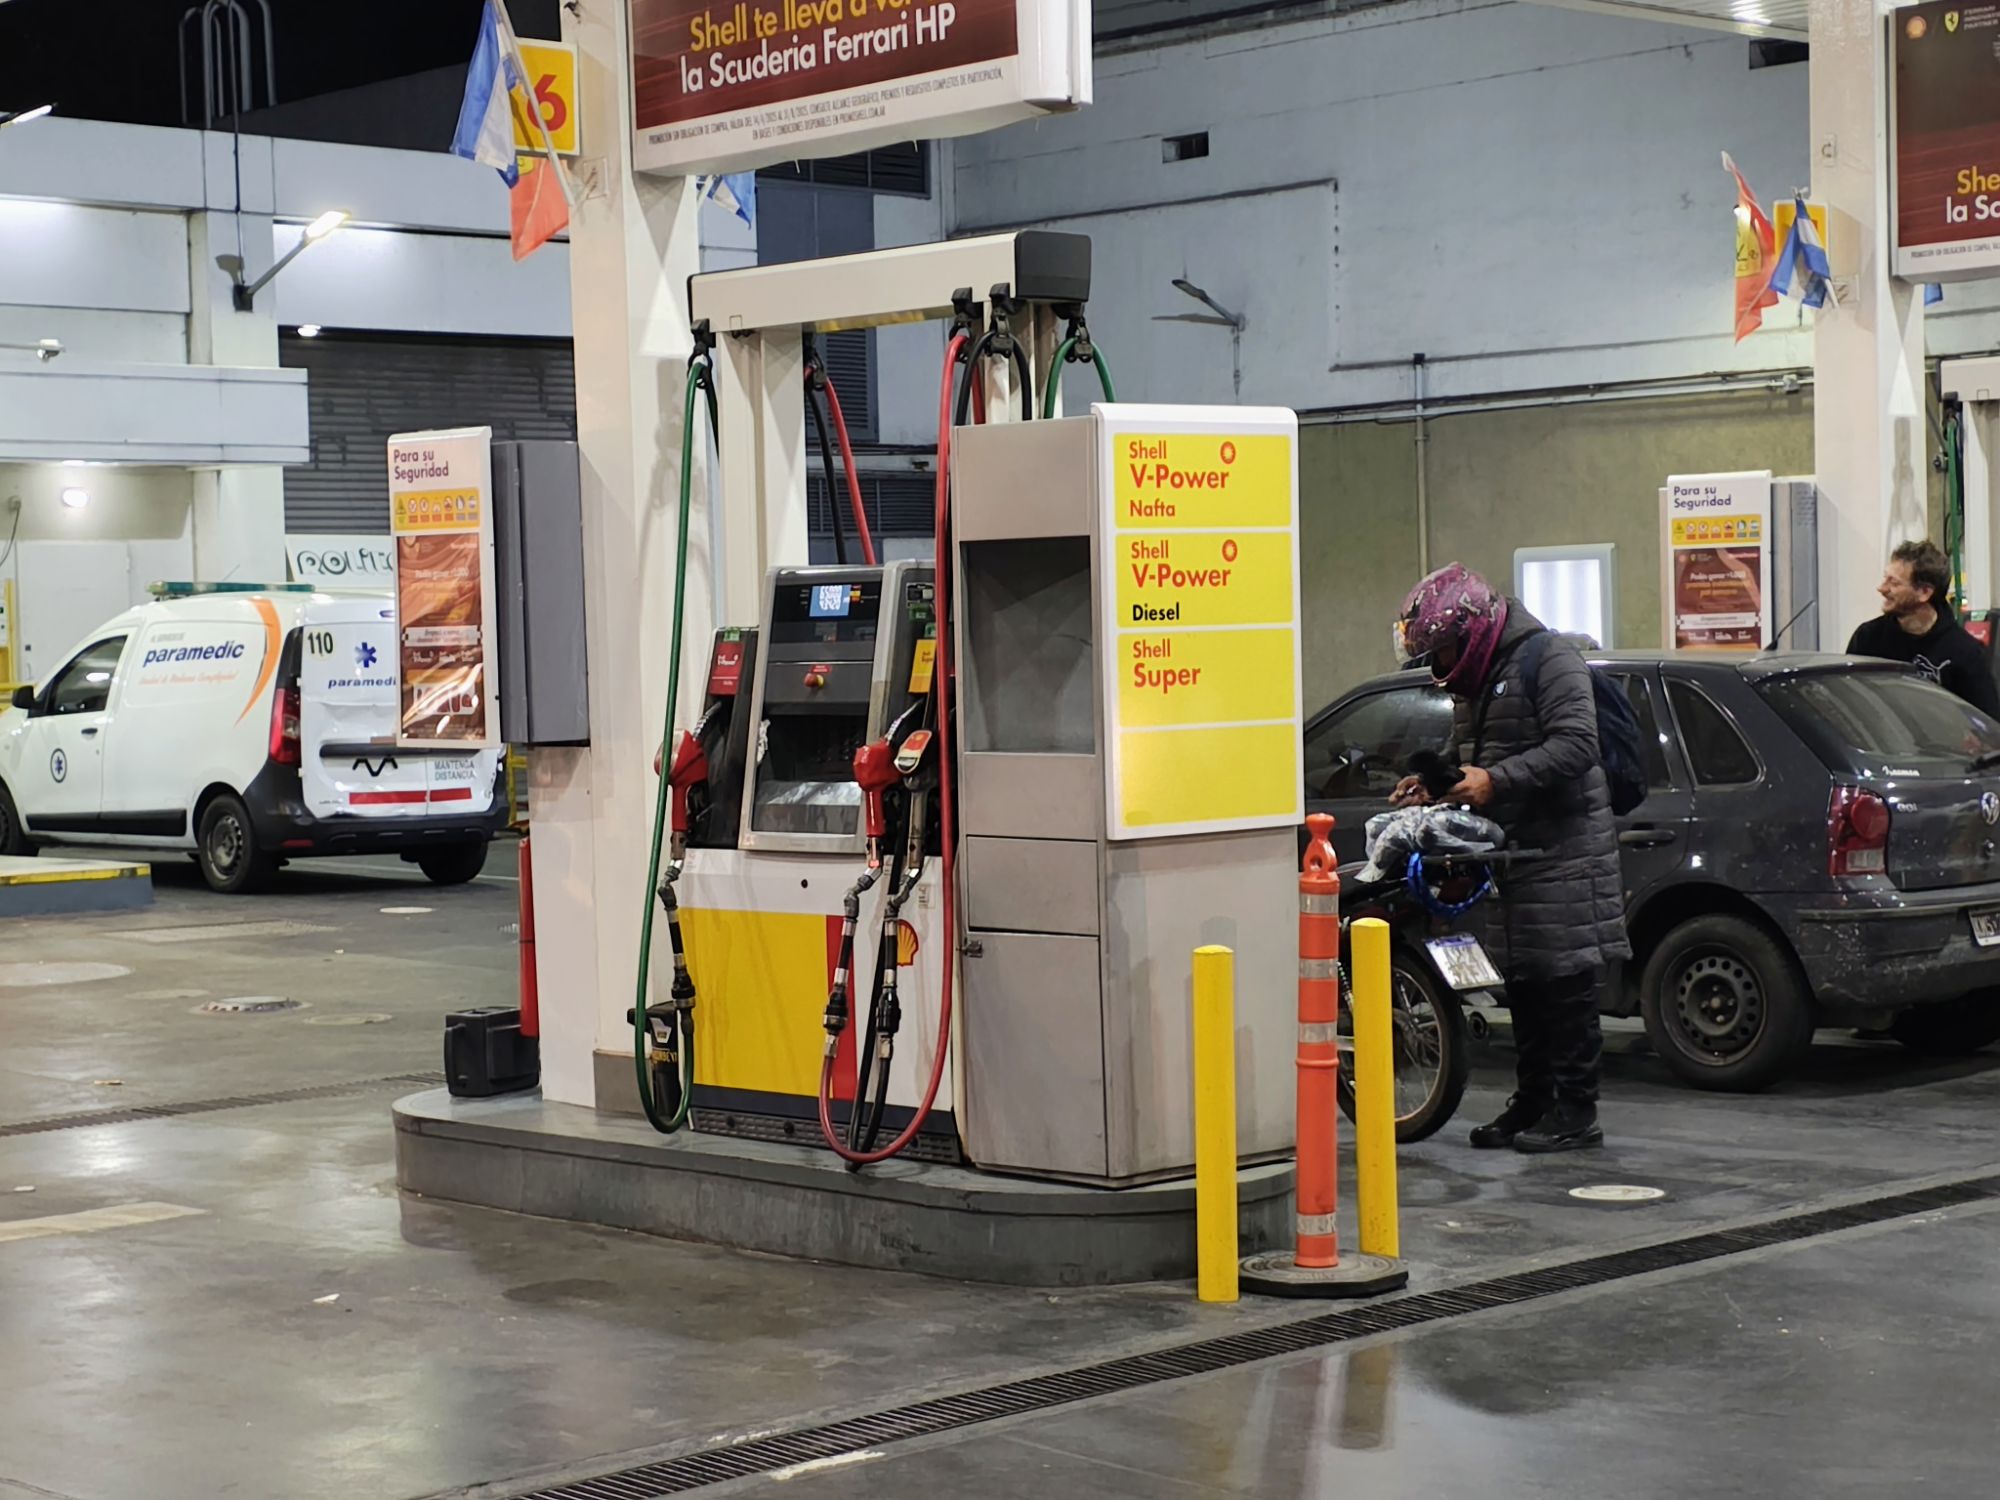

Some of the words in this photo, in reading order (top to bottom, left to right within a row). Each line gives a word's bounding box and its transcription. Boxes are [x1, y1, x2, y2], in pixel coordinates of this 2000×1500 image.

[691, 2, 747, 51] Shell
[754, 8, 778, 38] te
[784, 0, 843, 33] lleva
[681, 56, 703, 94] la
[709, 34, 816, 87] Scuderia
[823, 11, 908, 64] Ferrari
[915, 2, 956, 46] HP
[527, 74, 567, 131] 6
[1946, 196, 1968, 223] la
[394, 449, 420, 464] Para
[422, 450, 434, 462] su
[1129, 441, 1167, 460] Shell
[394, 462, 449, 483] Seguridad
[1129, 463, 1229, 490] V-Power
[1674, 486, 1700, 496] Para
[1705, 486, 1716, 494] su
[1130, 499, 1176, 518] Nafta
[1674, 495, 1731, 510] Seguridad
[1131, 540, 1169, 560] Shell
[1132, 563, 1231, 588] V-Power
[1133, 602, 1180, 622] Diesel
[308, 632, 334, 654] 110
[1133, 639, 1171, 659] Shell
[142, 640, 244, 668] paramedic
[1133, 663, 1201, 694] Super
[434, 760, 475, 771] MANTENGA
[434, 771, 476, 781] DISTANCIA
